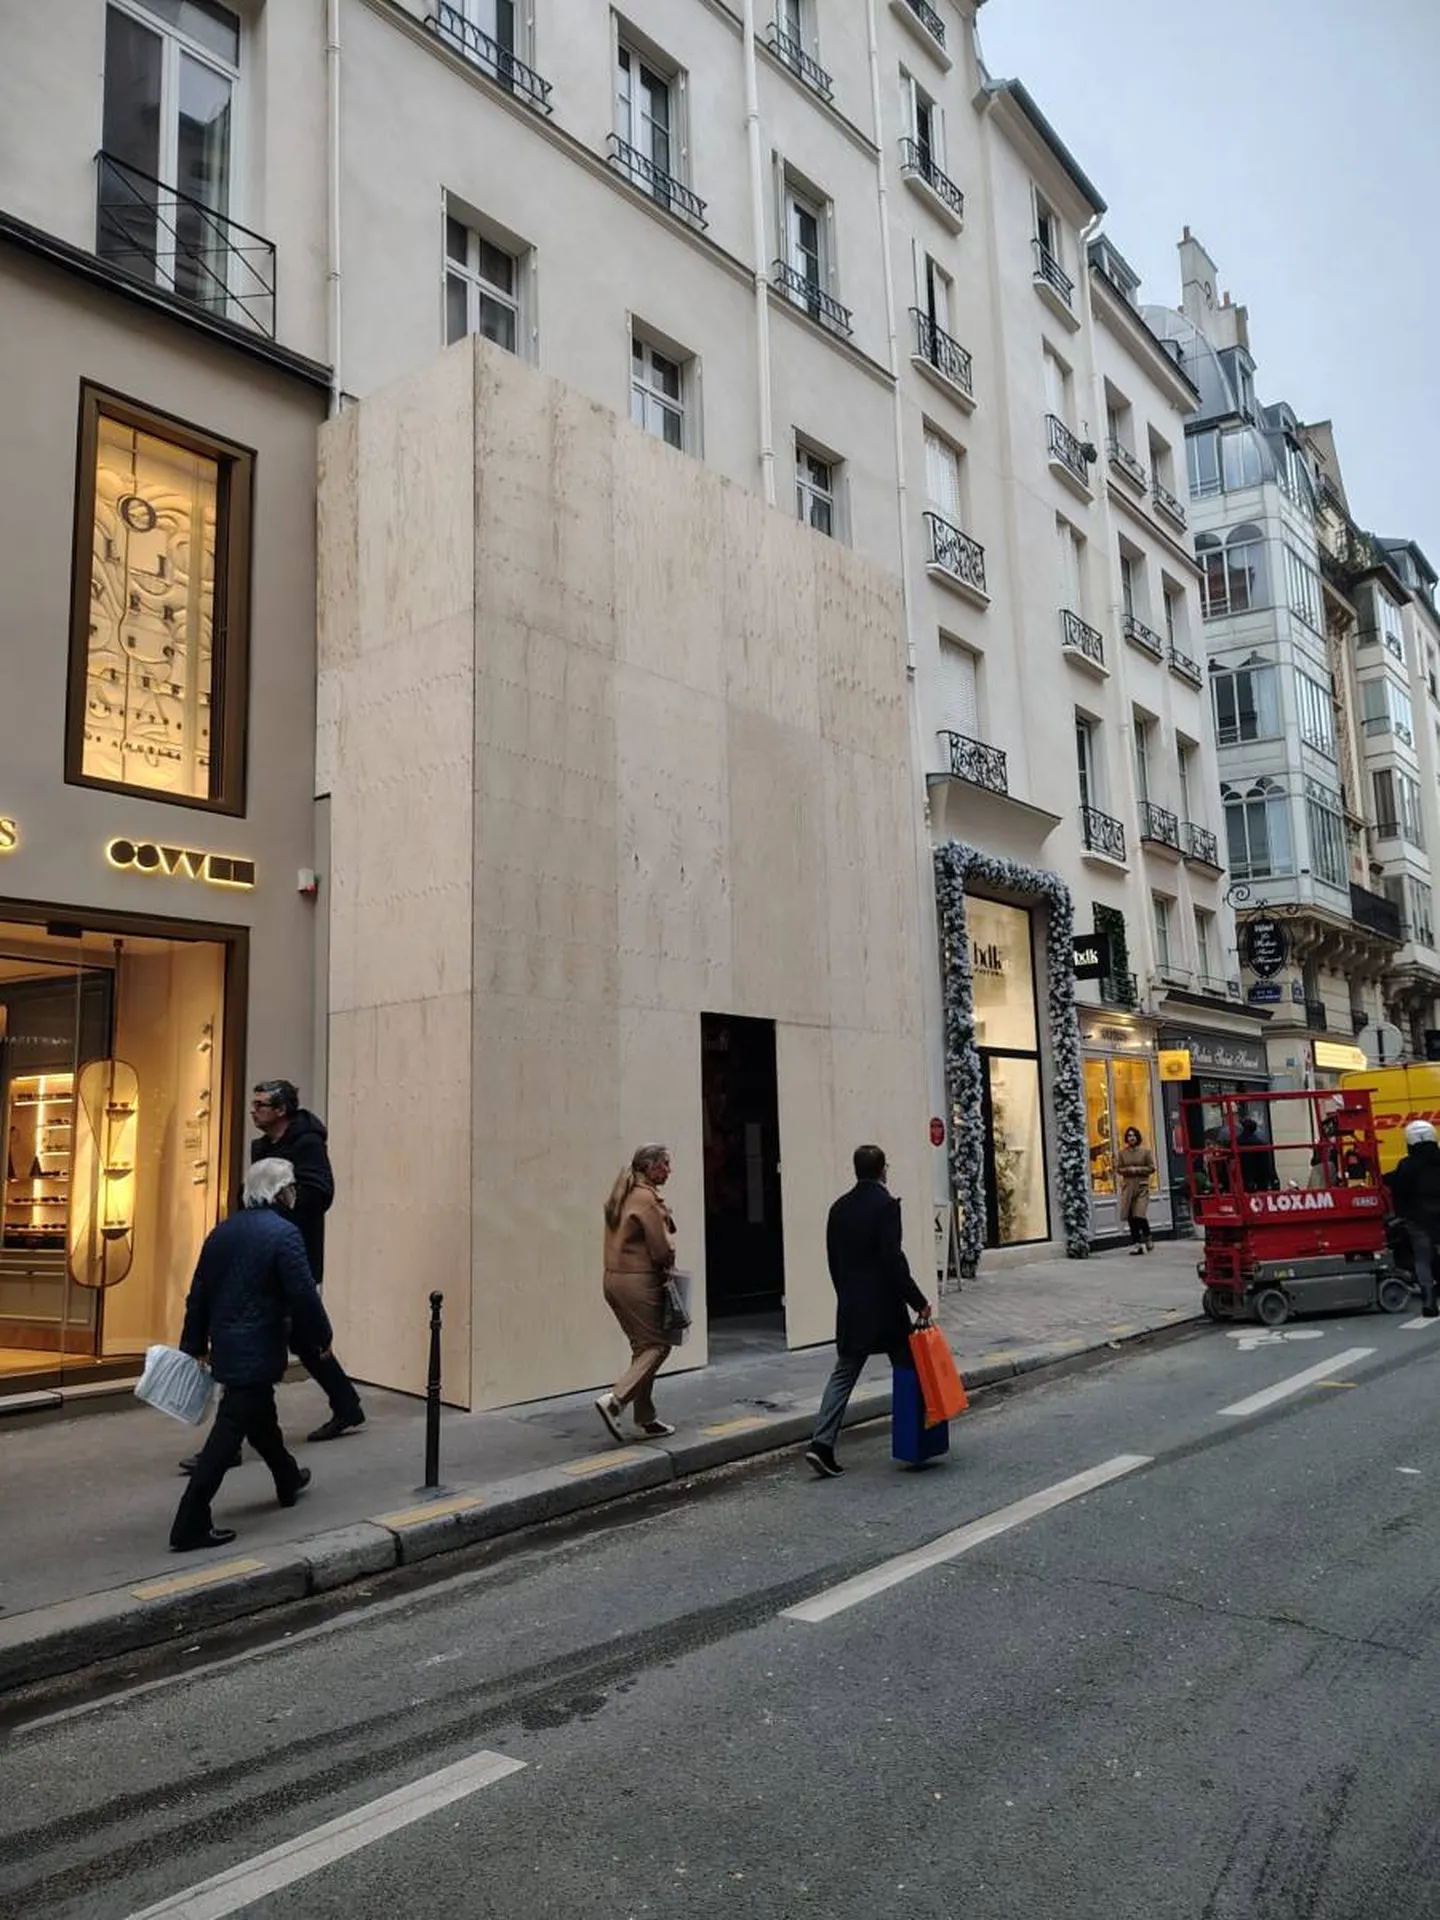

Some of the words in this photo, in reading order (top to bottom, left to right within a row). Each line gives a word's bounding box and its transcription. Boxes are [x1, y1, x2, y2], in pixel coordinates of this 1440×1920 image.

[121, 497, 157, 532] O
[1073, 948, 1099, 966] bdk
[1266, 1191, 1335, 1212] LOXAM
